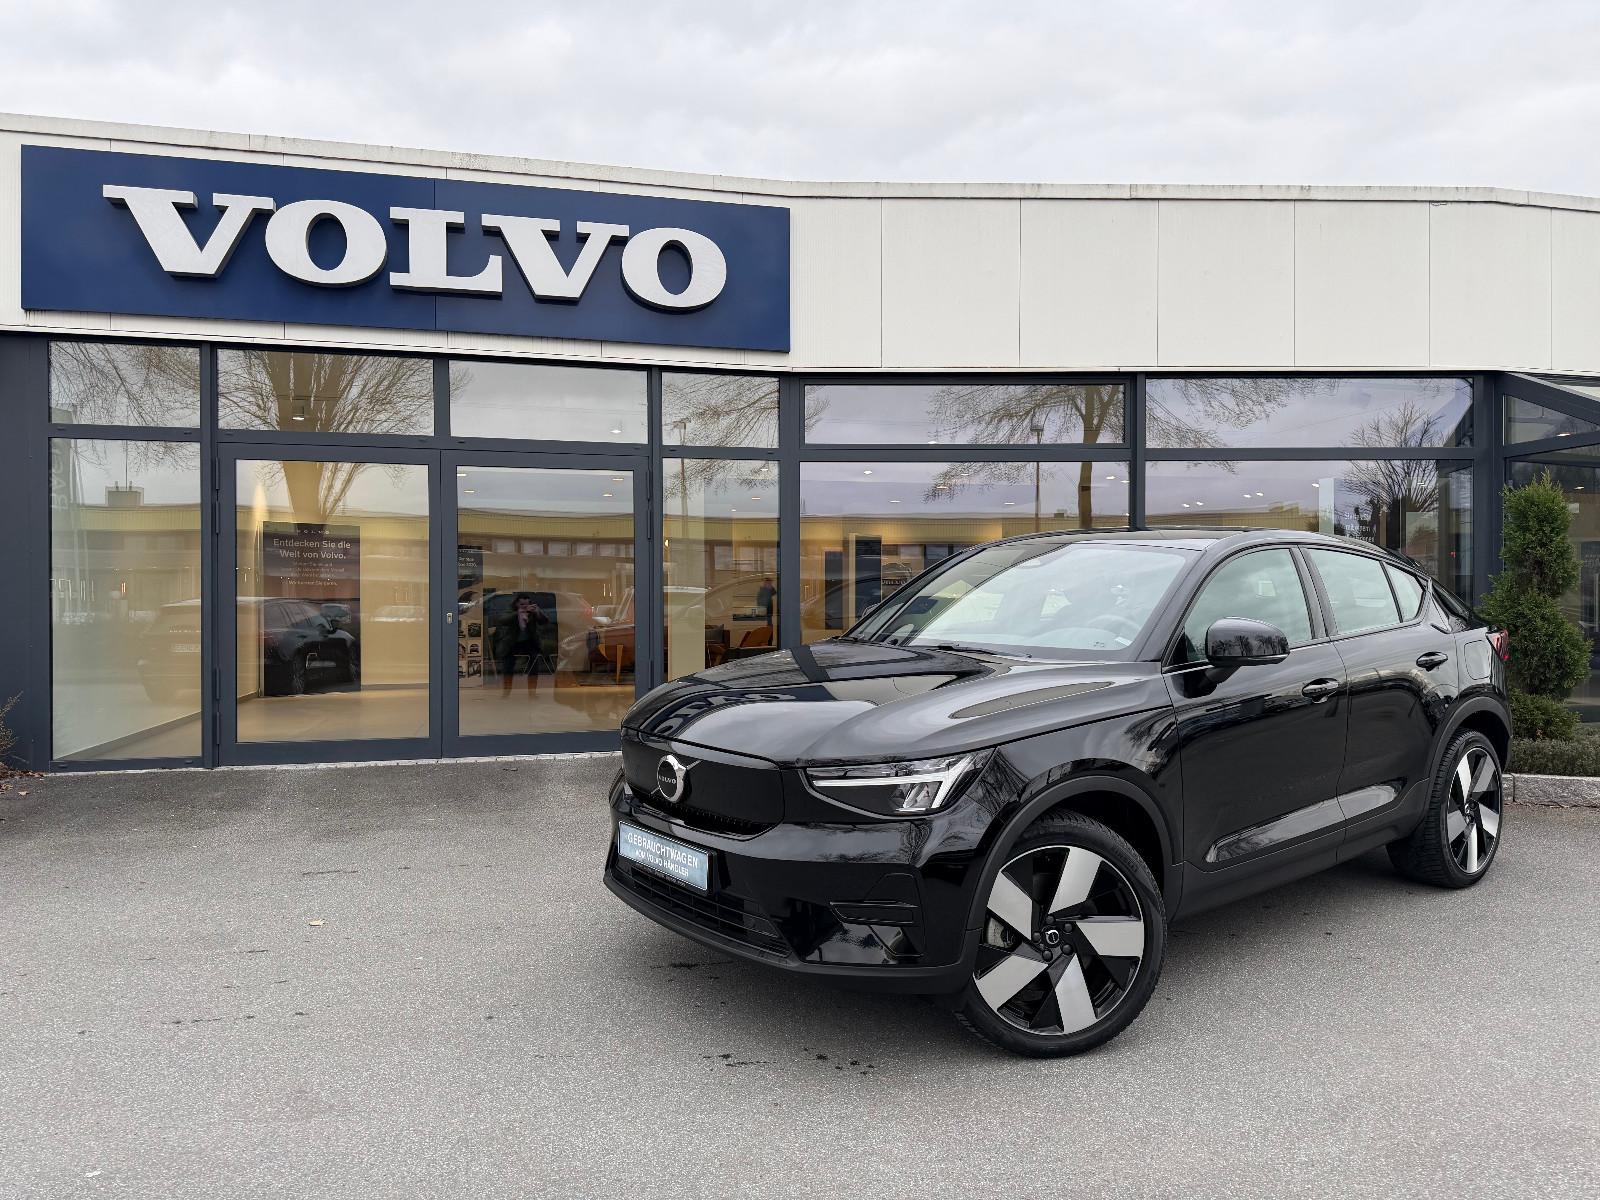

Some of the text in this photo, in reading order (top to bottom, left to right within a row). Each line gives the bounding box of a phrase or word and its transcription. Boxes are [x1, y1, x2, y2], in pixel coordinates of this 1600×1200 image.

[102, 184, 727, 311] VOLVO
[273, 538, 351, 549] Entdecken Sie die
[279, 549, 347, 560] Welt von Volvo.
[627, 832, 699, 869] GEBRAUCHTWAGEN
